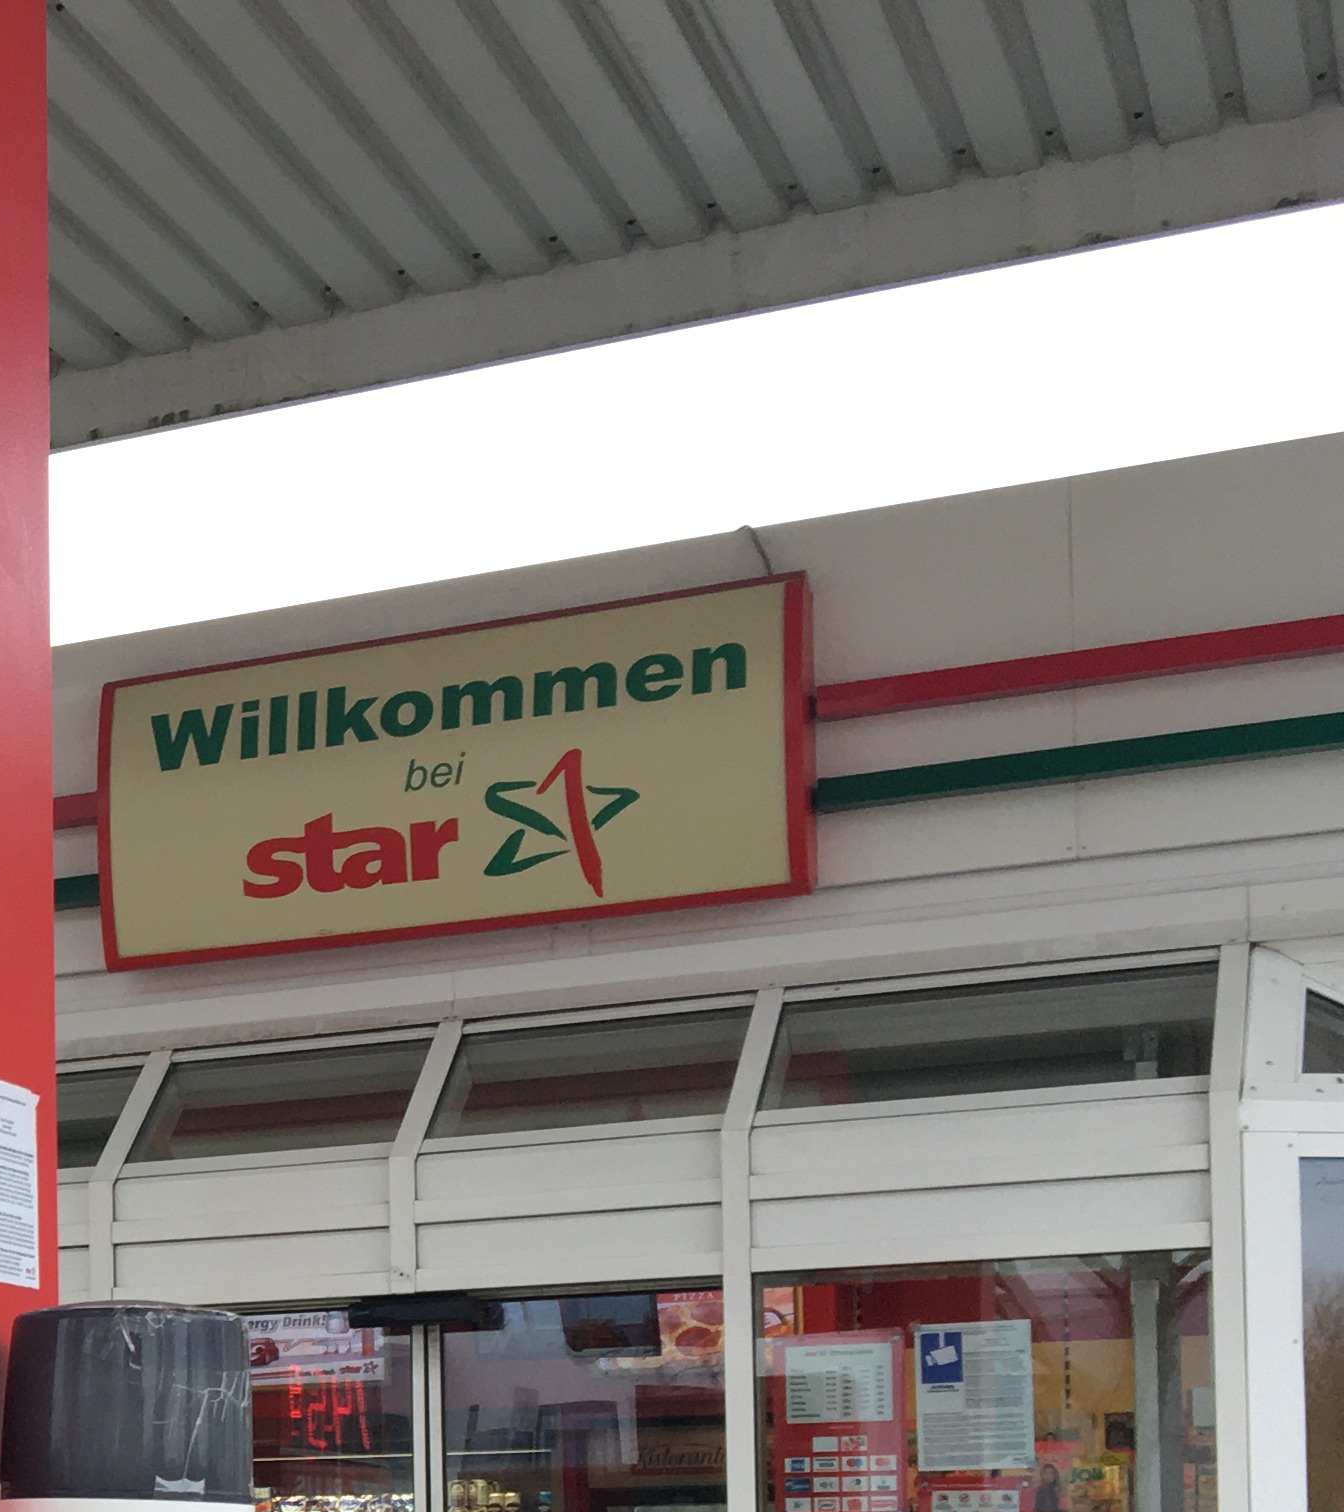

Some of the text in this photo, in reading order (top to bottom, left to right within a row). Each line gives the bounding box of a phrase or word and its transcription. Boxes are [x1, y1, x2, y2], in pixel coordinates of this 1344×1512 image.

[151, 642, 747, 772] Willkommen
[405, 753, 466, 793] bei
[243, 813, 459, 898] star
[673, 1291, 715, 1301] PIZZA
[282, 1314, 327, 1328] Drink!
